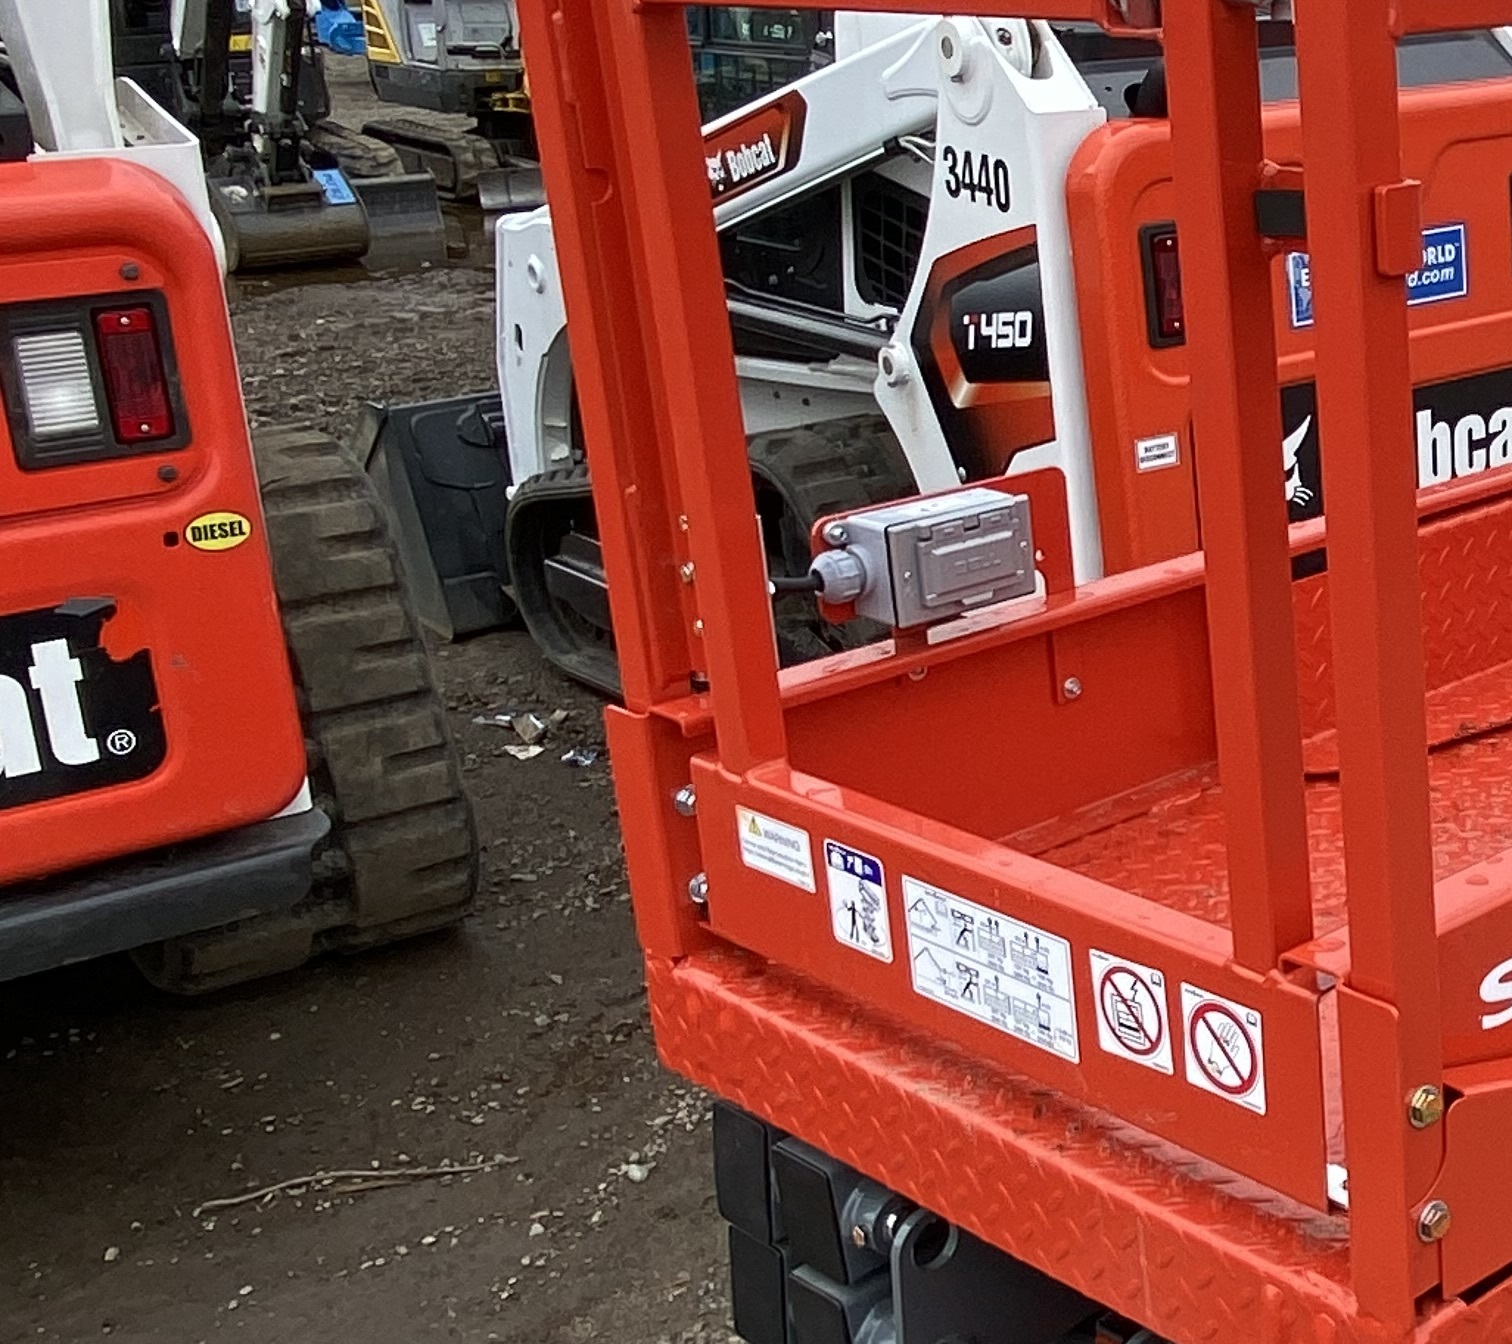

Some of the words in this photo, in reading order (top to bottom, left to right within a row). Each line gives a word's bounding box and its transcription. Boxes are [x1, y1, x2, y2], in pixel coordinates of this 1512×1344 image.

[725, 133, 776, 182] Bobcat
[943, 145, 1010, 213] 3440
[1422, 242, 1456, 267] RLD
[963, 310, 1033, 350] T450
[191, 520, 247, 542] DIESEL
